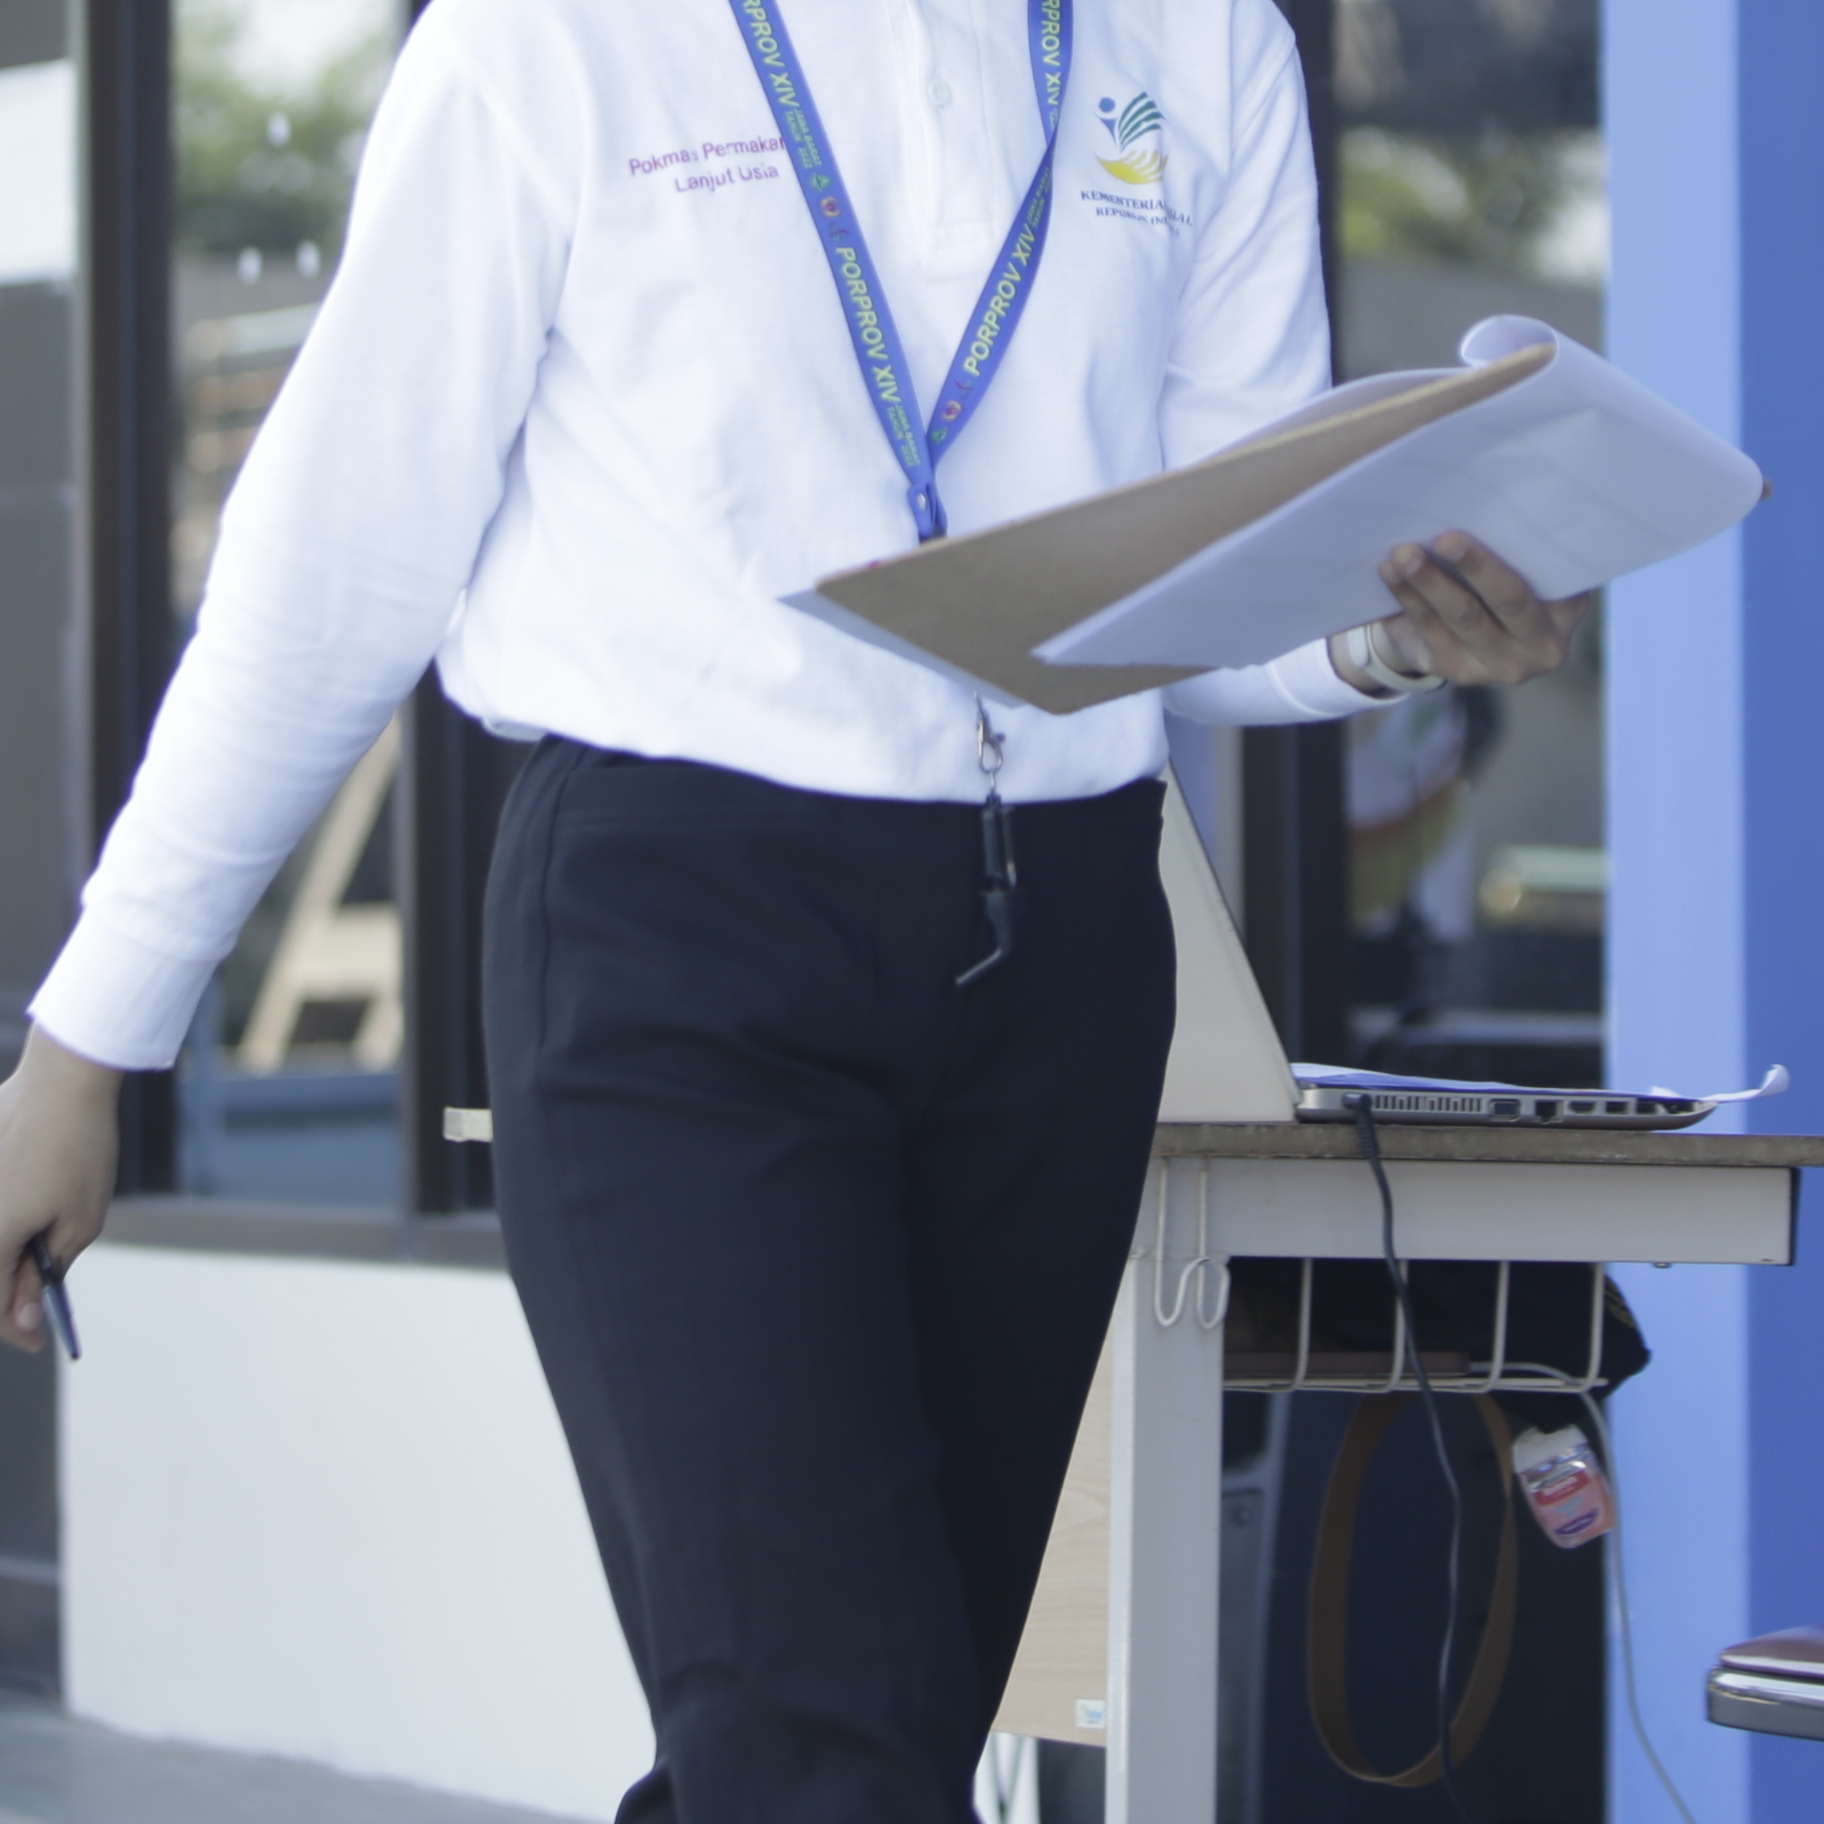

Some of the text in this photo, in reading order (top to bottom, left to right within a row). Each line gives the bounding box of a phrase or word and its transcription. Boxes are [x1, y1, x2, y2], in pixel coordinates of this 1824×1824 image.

[769, 72, 800, 107] XIV
[1045, 71, 1061, 106] XIV
[629, 149, 699, 176] Pokmas
[674, 162, 779, 192] Lanjut Usia
[963, 223, 1037, 376] PORPROV XIV
[835, 246, 902, 403] PORPROV XIV
